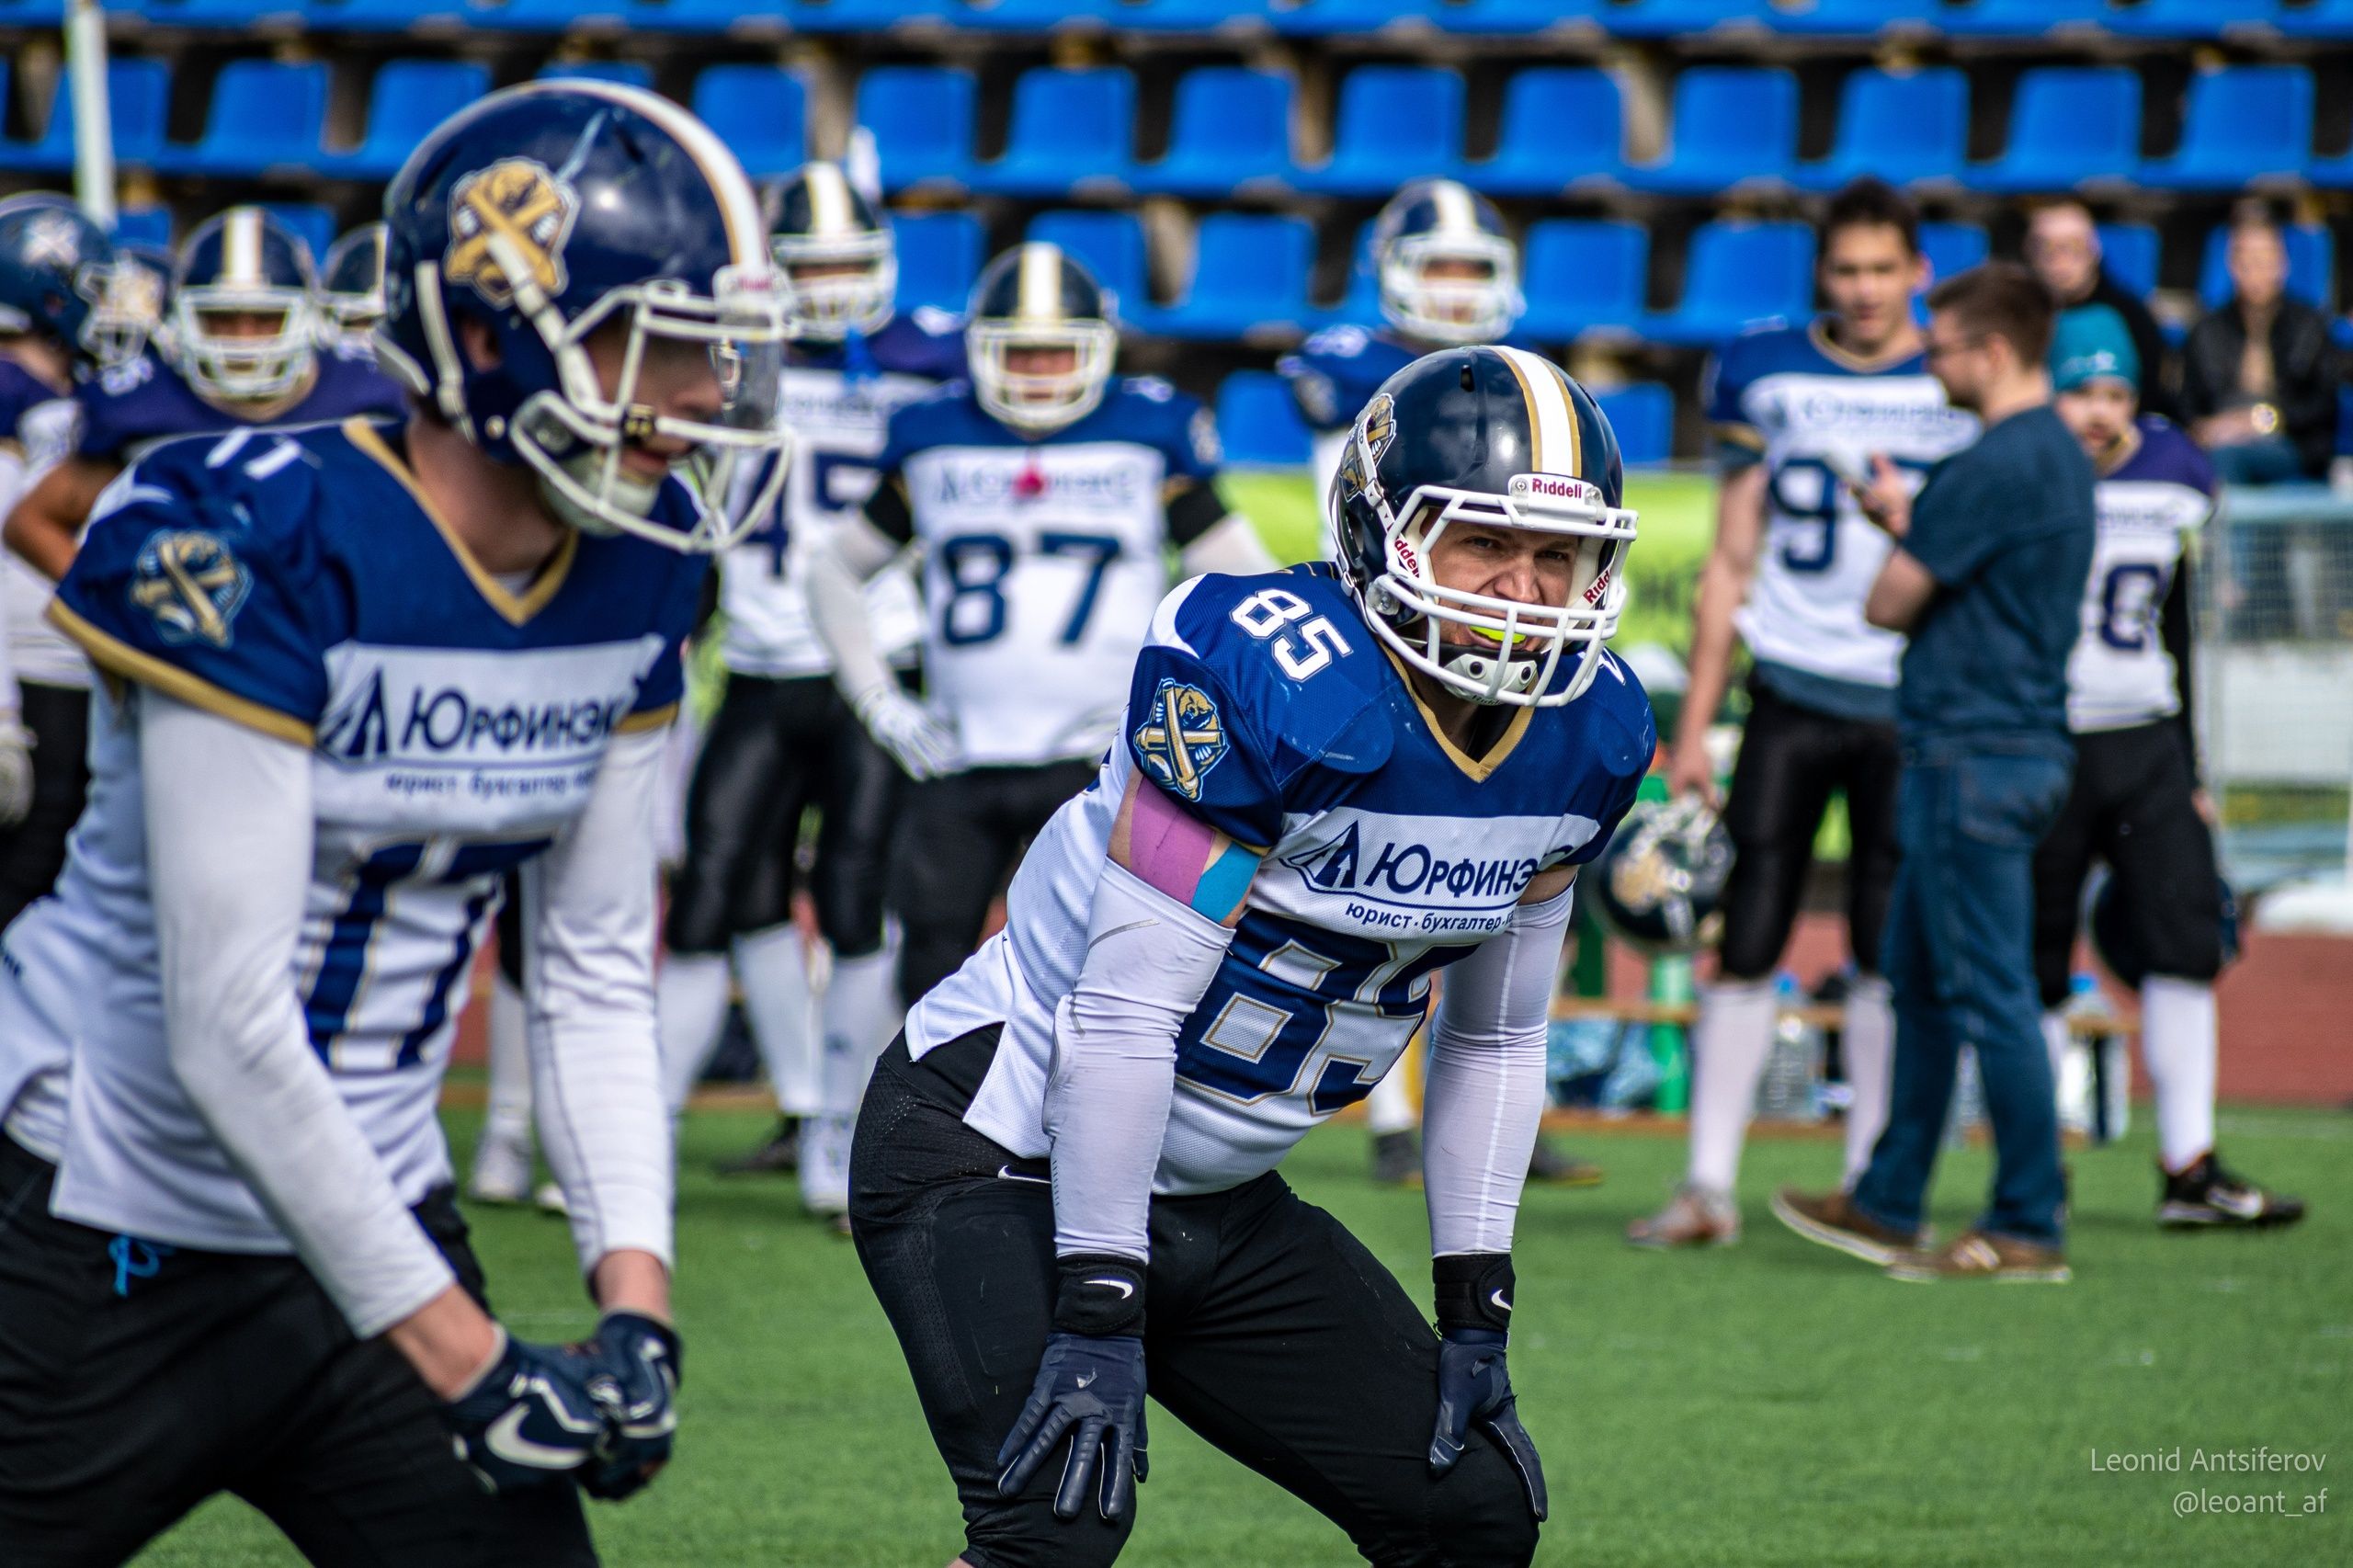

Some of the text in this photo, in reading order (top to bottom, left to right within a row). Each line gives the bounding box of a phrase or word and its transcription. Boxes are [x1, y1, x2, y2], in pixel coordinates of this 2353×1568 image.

[1532, 478, 1582, 498] Riddell
[941, 532, 1117, 648] 87
[1229, 588, 1354, 683] 85
[1174, 905, 1481, 1117] 85
